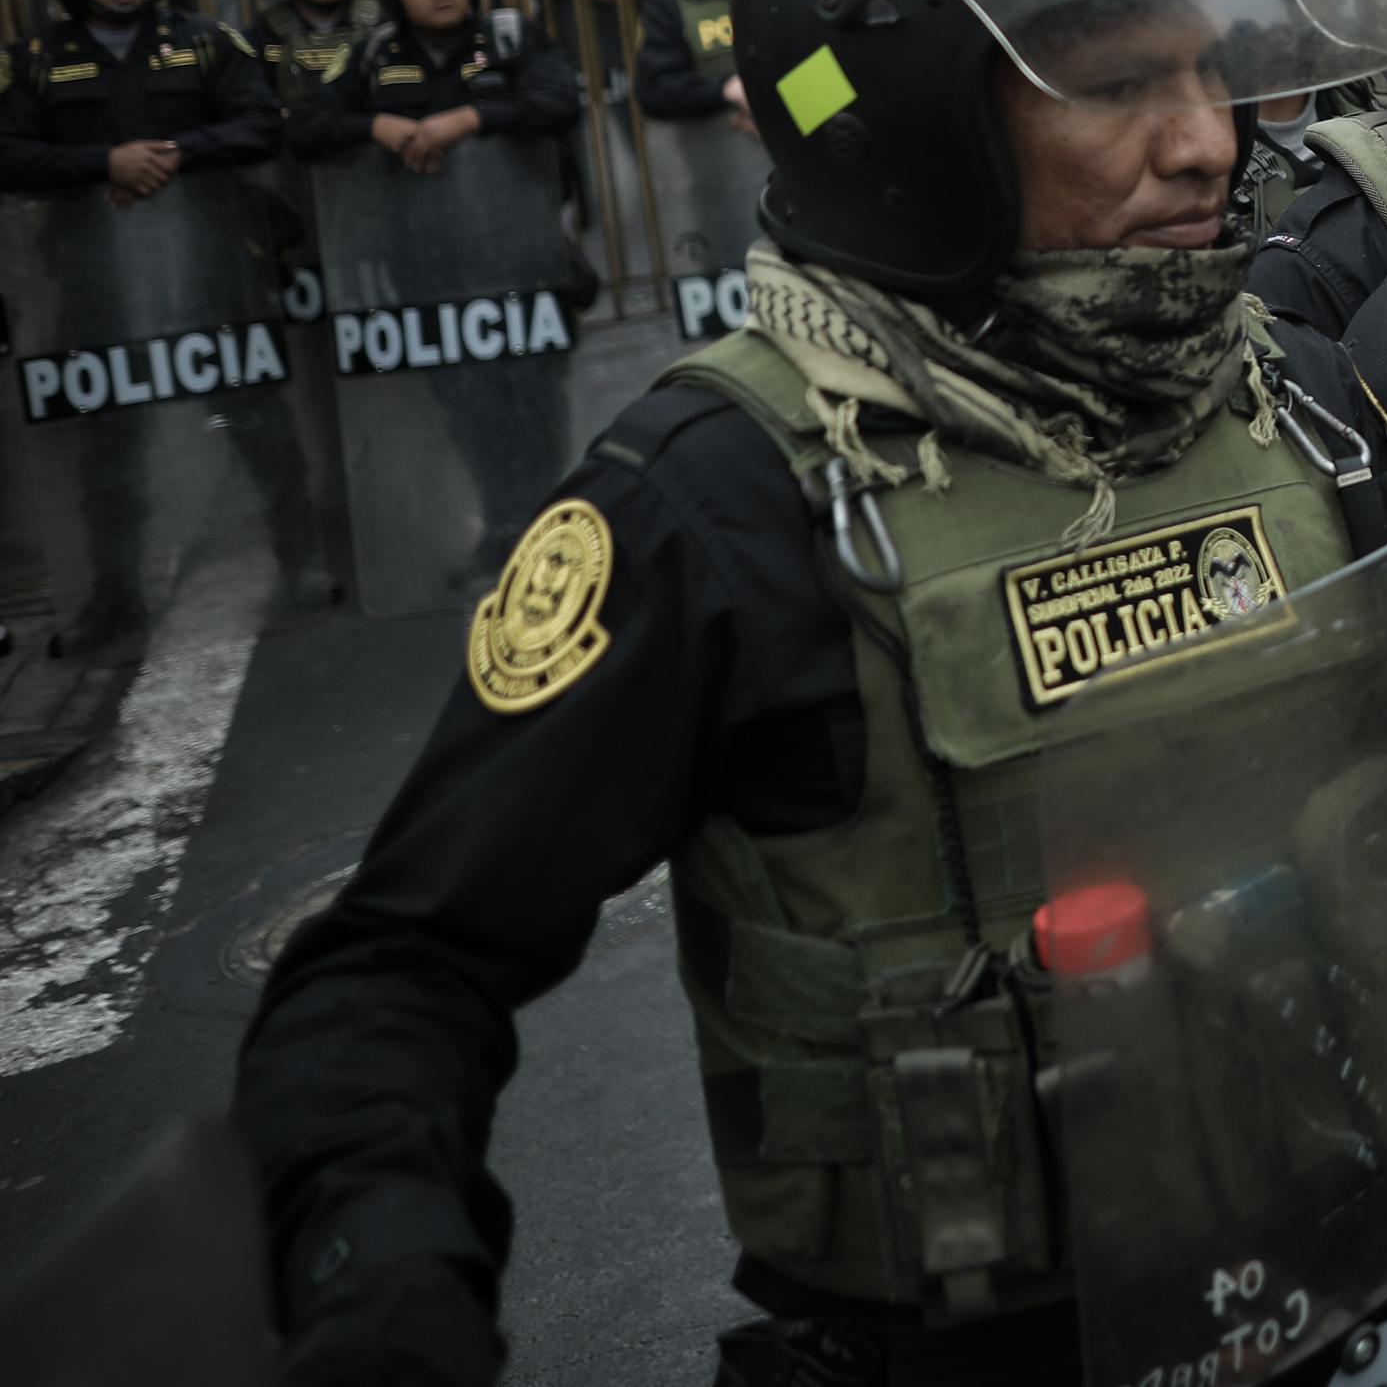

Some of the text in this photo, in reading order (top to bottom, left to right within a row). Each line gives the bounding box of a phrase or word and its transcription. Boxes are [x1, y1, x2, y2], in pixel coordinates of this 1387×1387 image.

[24, 322, 287, 420] POLICIA
[335, 290, 570, 374] POLICIA
[1023, 577, 1049, 600] V.
[1154, 563, 1194, 588] 2022
[1033, 587, 1213, 686] POLICIA
